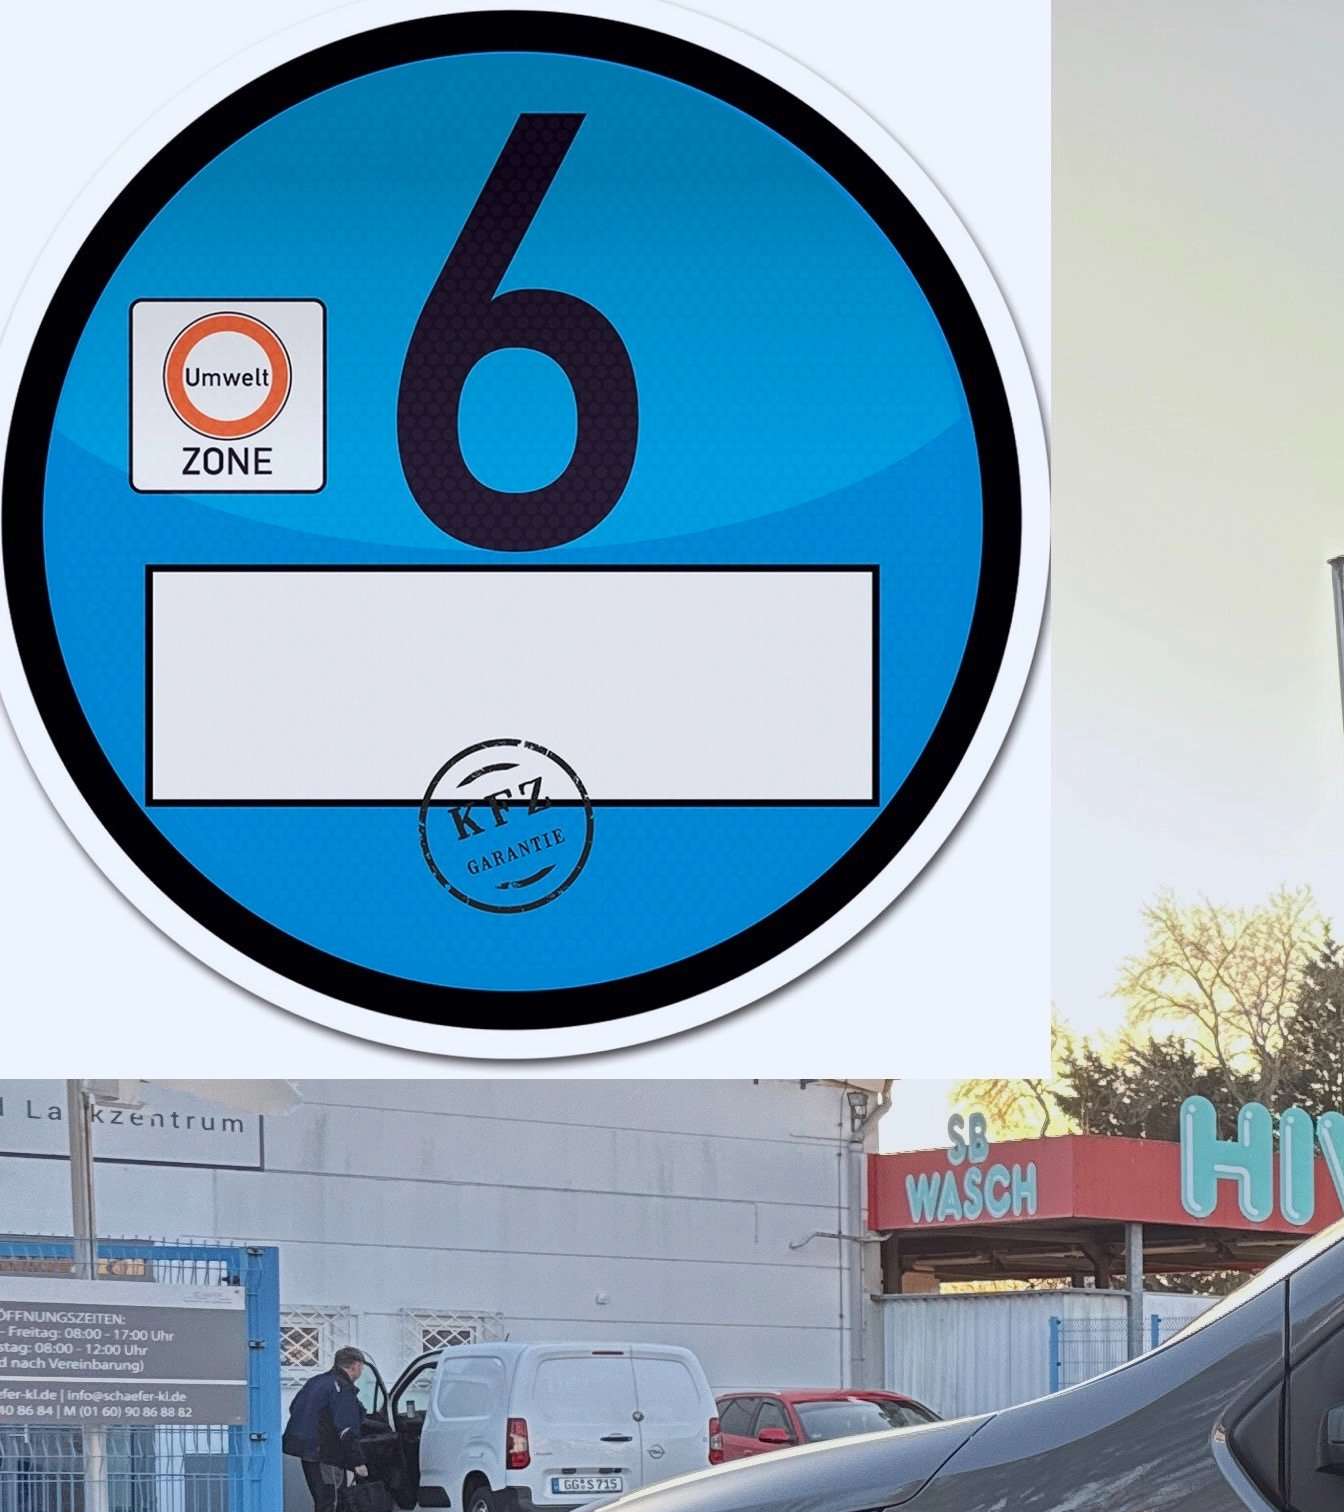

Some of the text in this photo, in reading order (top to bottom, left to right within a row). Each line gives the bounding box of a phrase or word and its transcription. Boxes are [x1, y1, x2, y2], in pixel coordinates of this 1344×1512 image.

[26, 1099, 245, 1133] Lakzentrum
[947, 1112, 989, 1166] SB
[905, 1161, 1037, 1224] WASCH
[8, 1325, 62, 1341] Freitag:
[64, 1327, 102, 1340] 08:00
[114, 1329, 149, 1341] 17:00
[151, 1330, 175, 1342] Uhr
[34, 1342, 74, 1354] 08:00
[86, 1343, 122, 1356] 12:00
[124, 1344, 149, 1356] Uhr
[10, 1357, 46, 1369] nach
[48, 1358, 145, 1374] Vereinbarung)
[63, 1406, 77, 1417] M
